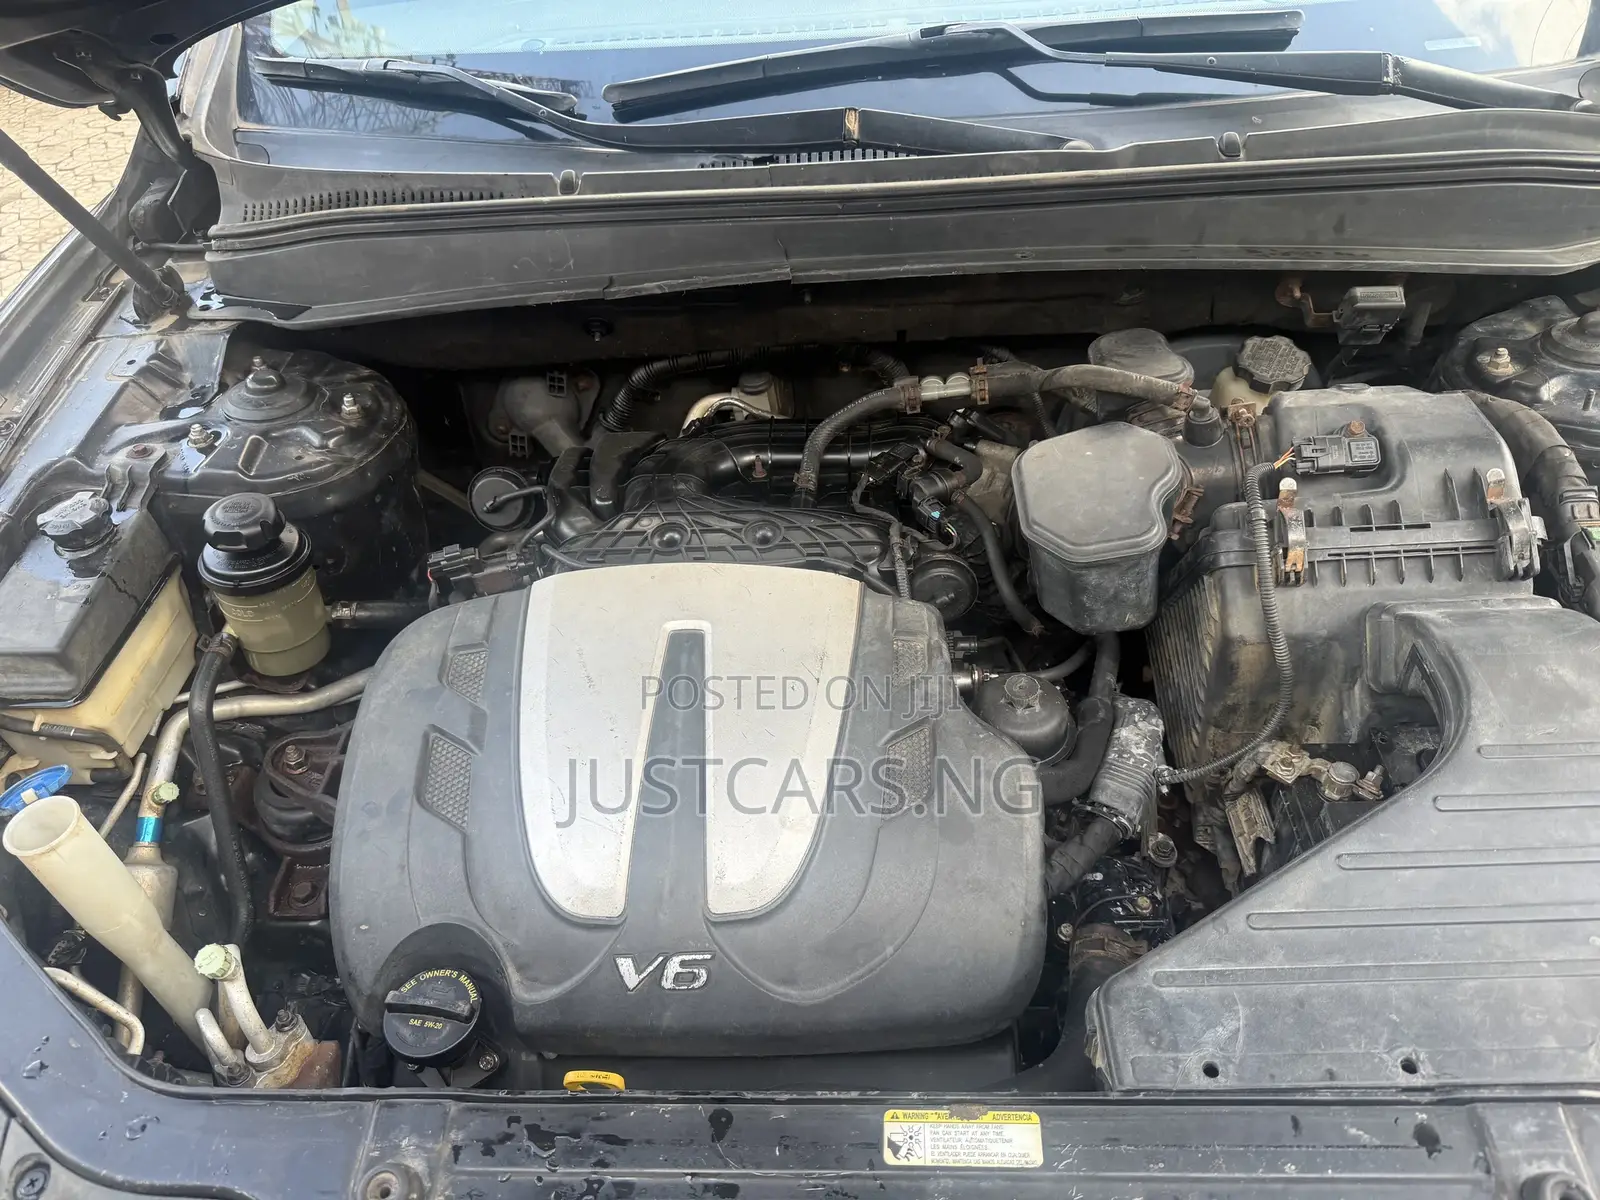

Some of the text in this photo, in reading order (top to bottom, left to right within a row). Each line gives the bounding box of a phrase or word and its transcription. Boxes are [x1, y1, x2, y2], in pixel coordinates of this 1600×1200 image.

[614, 951, 714, 992] V6
[400, 978, 419, 994] SEE
[419, 969, 459, 981] OWNER'S
[458, 974, 478, 1004] MANUAL
[408, 1018, 444, 1030] SAE 5W-20
[902, 1112, 929, 1121] WARNING
[992, 1113, 1033, 1122] ADVERTENCIA
